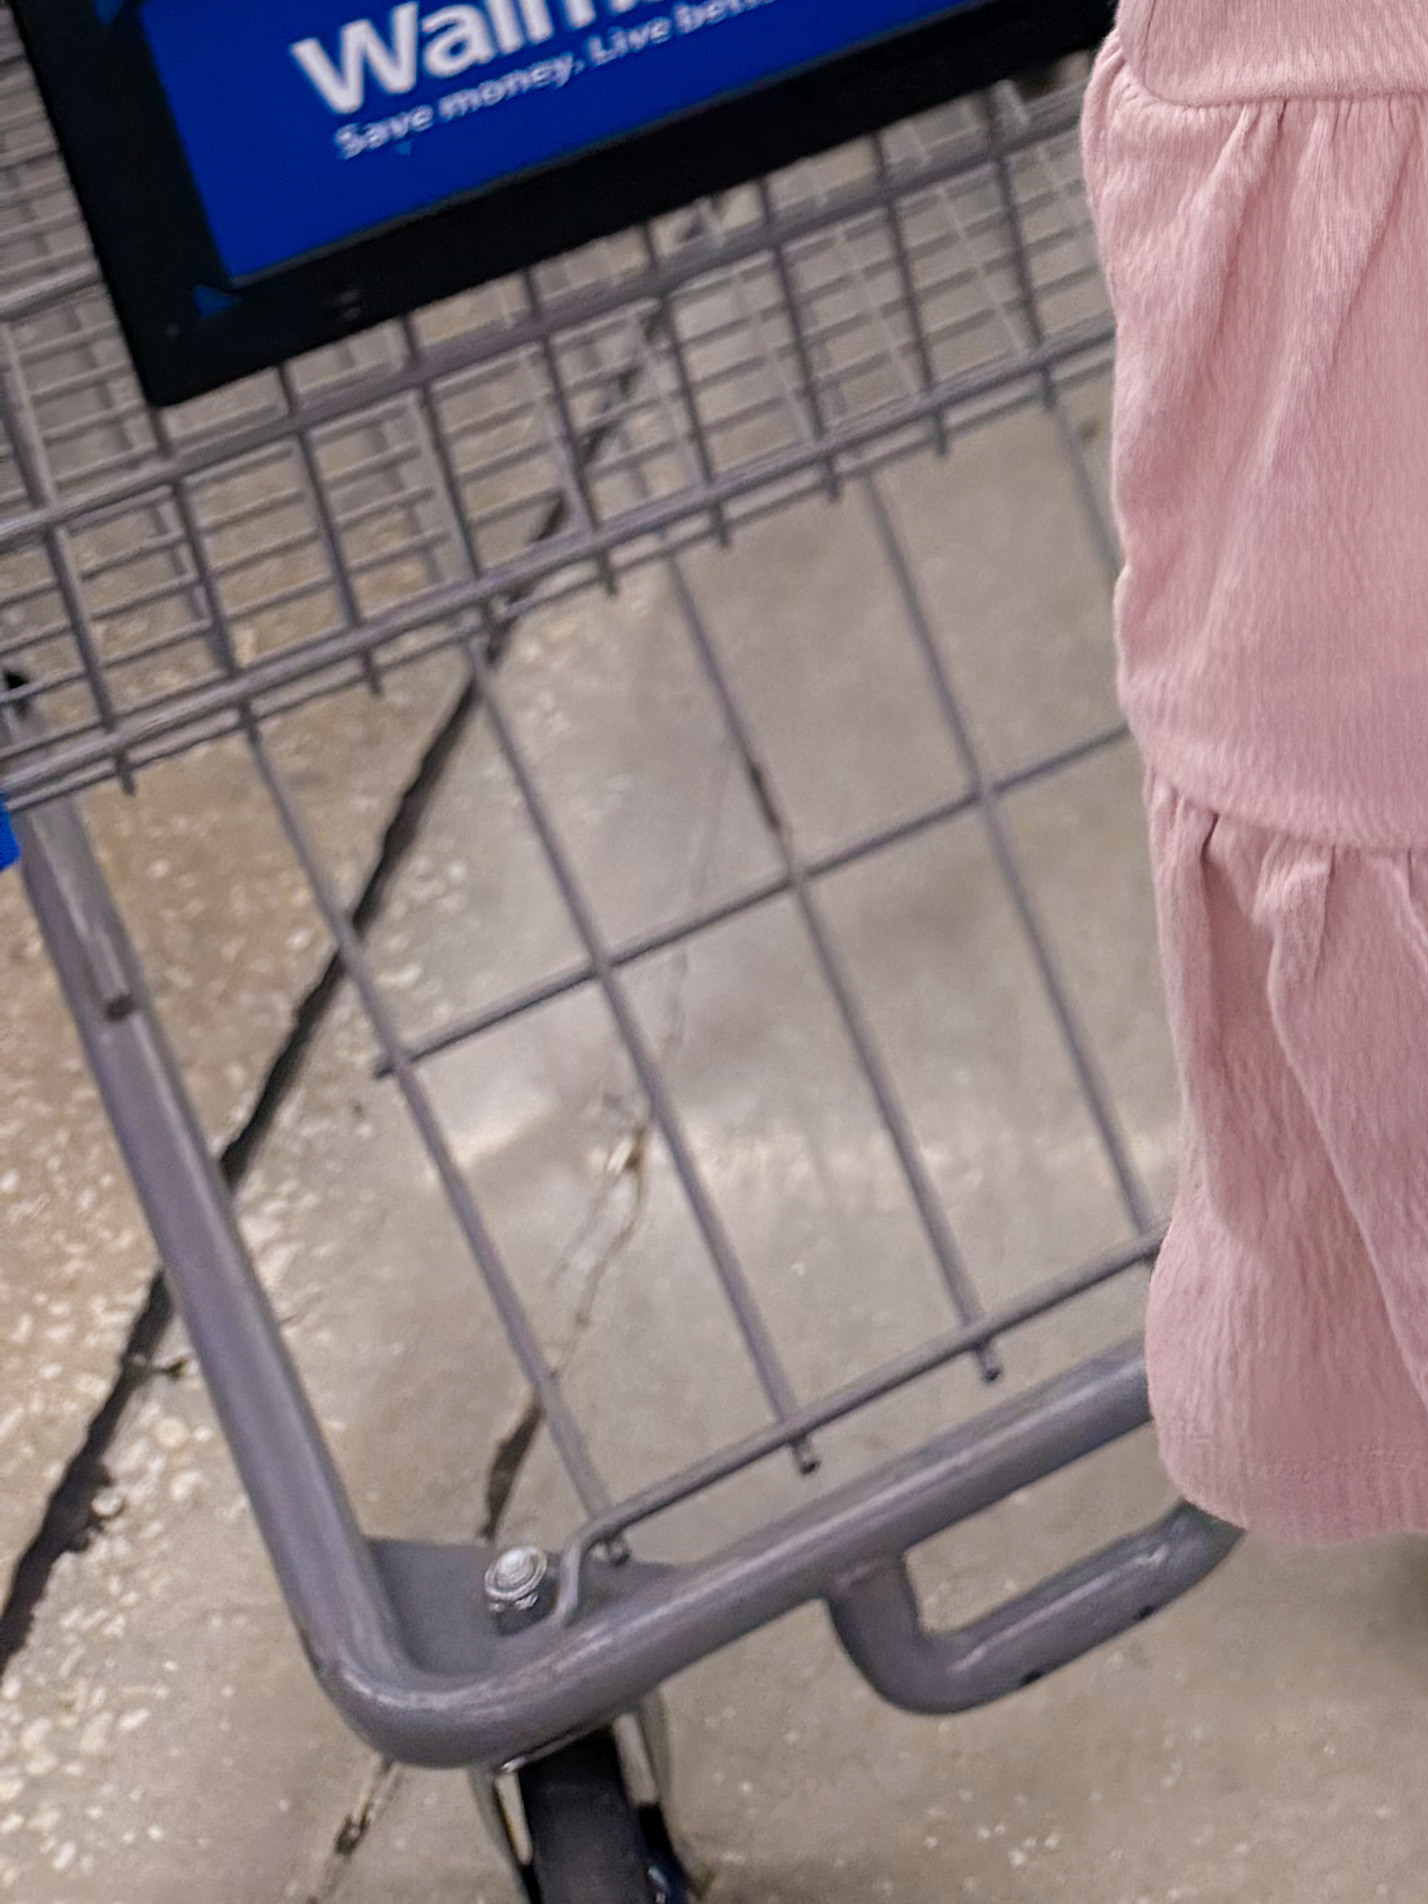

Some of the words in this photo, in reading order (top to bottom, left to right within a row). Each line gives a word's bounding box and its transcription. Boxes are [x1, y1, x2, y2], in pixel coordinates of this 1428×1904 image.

[333, 103, 435, 161] Save
[438, 51, 586, 123] money.
[584, 15, 672, 68] Live
